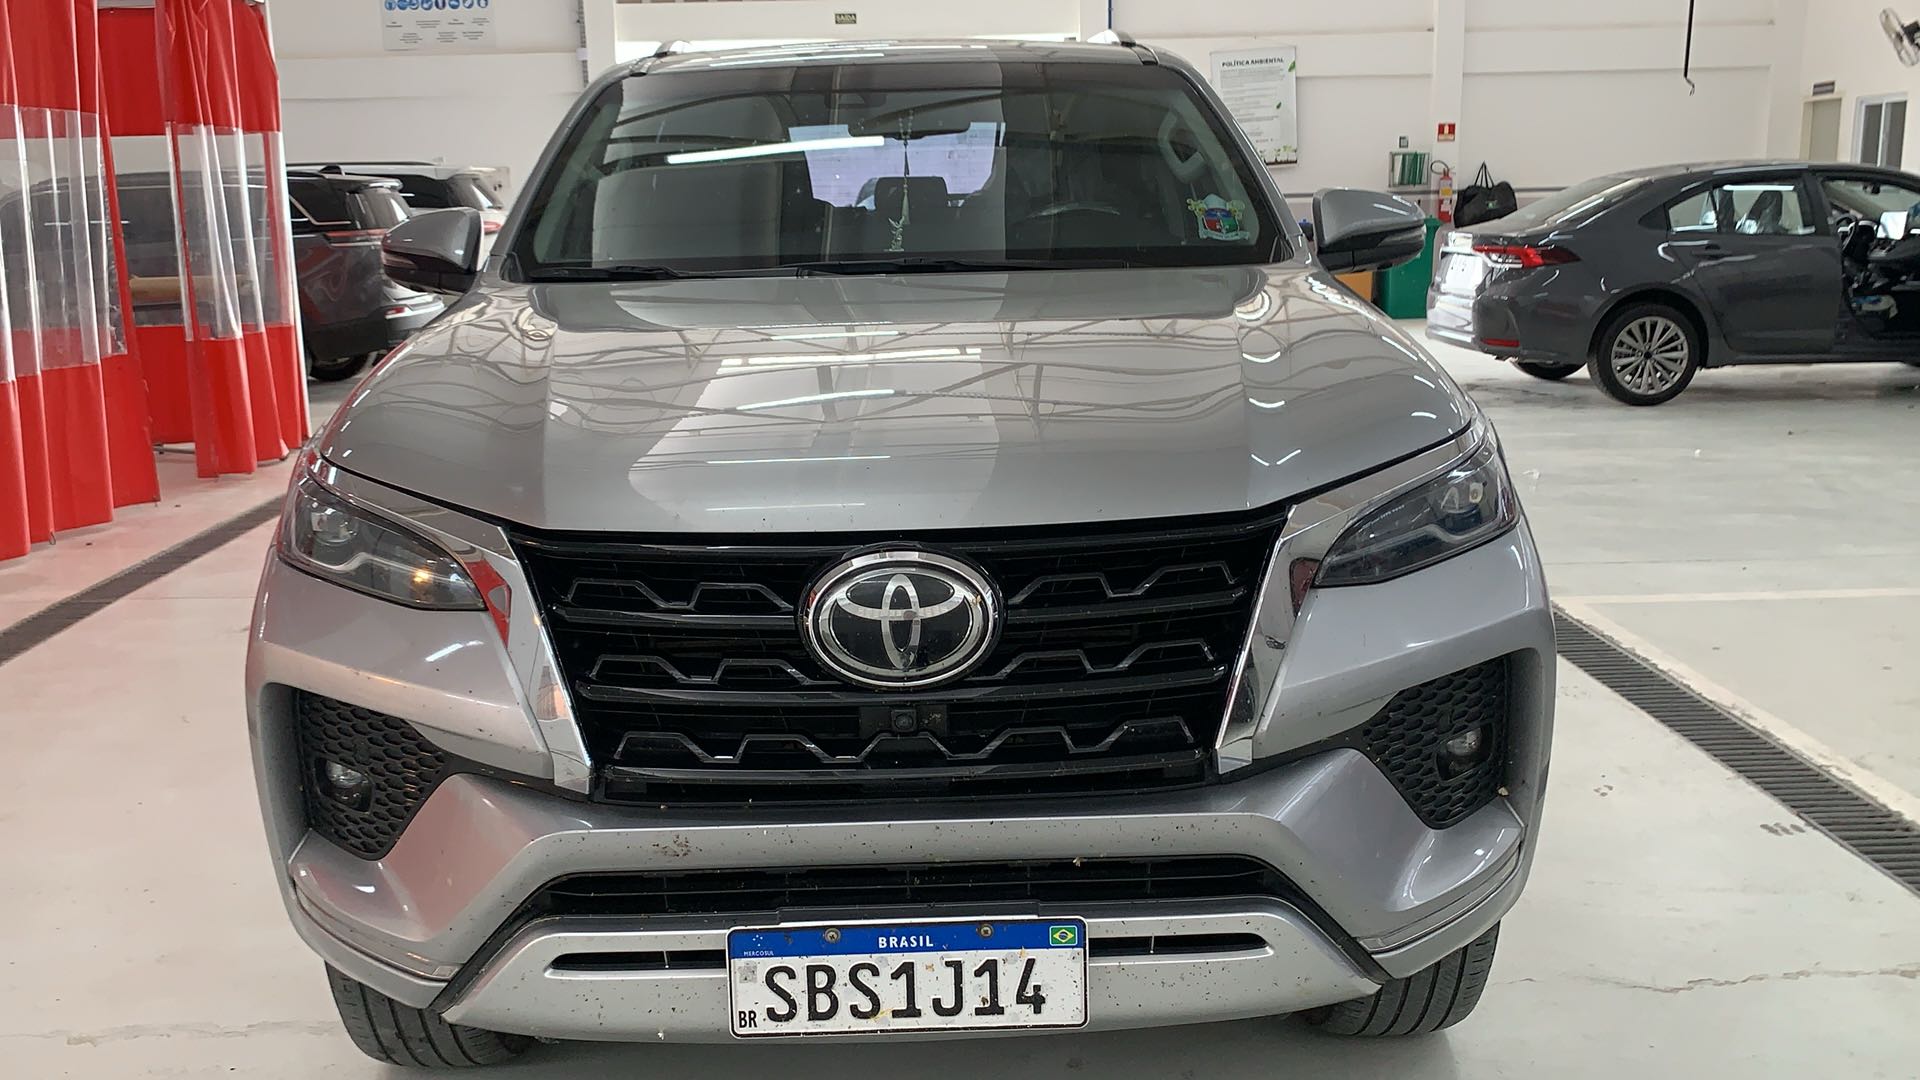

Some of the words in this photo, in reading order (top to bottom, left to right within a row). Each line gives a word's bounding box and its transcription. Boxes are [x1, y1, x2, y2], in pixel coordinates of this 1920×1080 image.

[1222, 59, 1250, 67] POLÍTICA
[1250, 57, 1284, 65] AMBIENTAL
[878, 934, 934, 949] BRASIL
[764, 957, 1047, 1022] SBS1J14
[738, 1010, 757, 1028] BR
